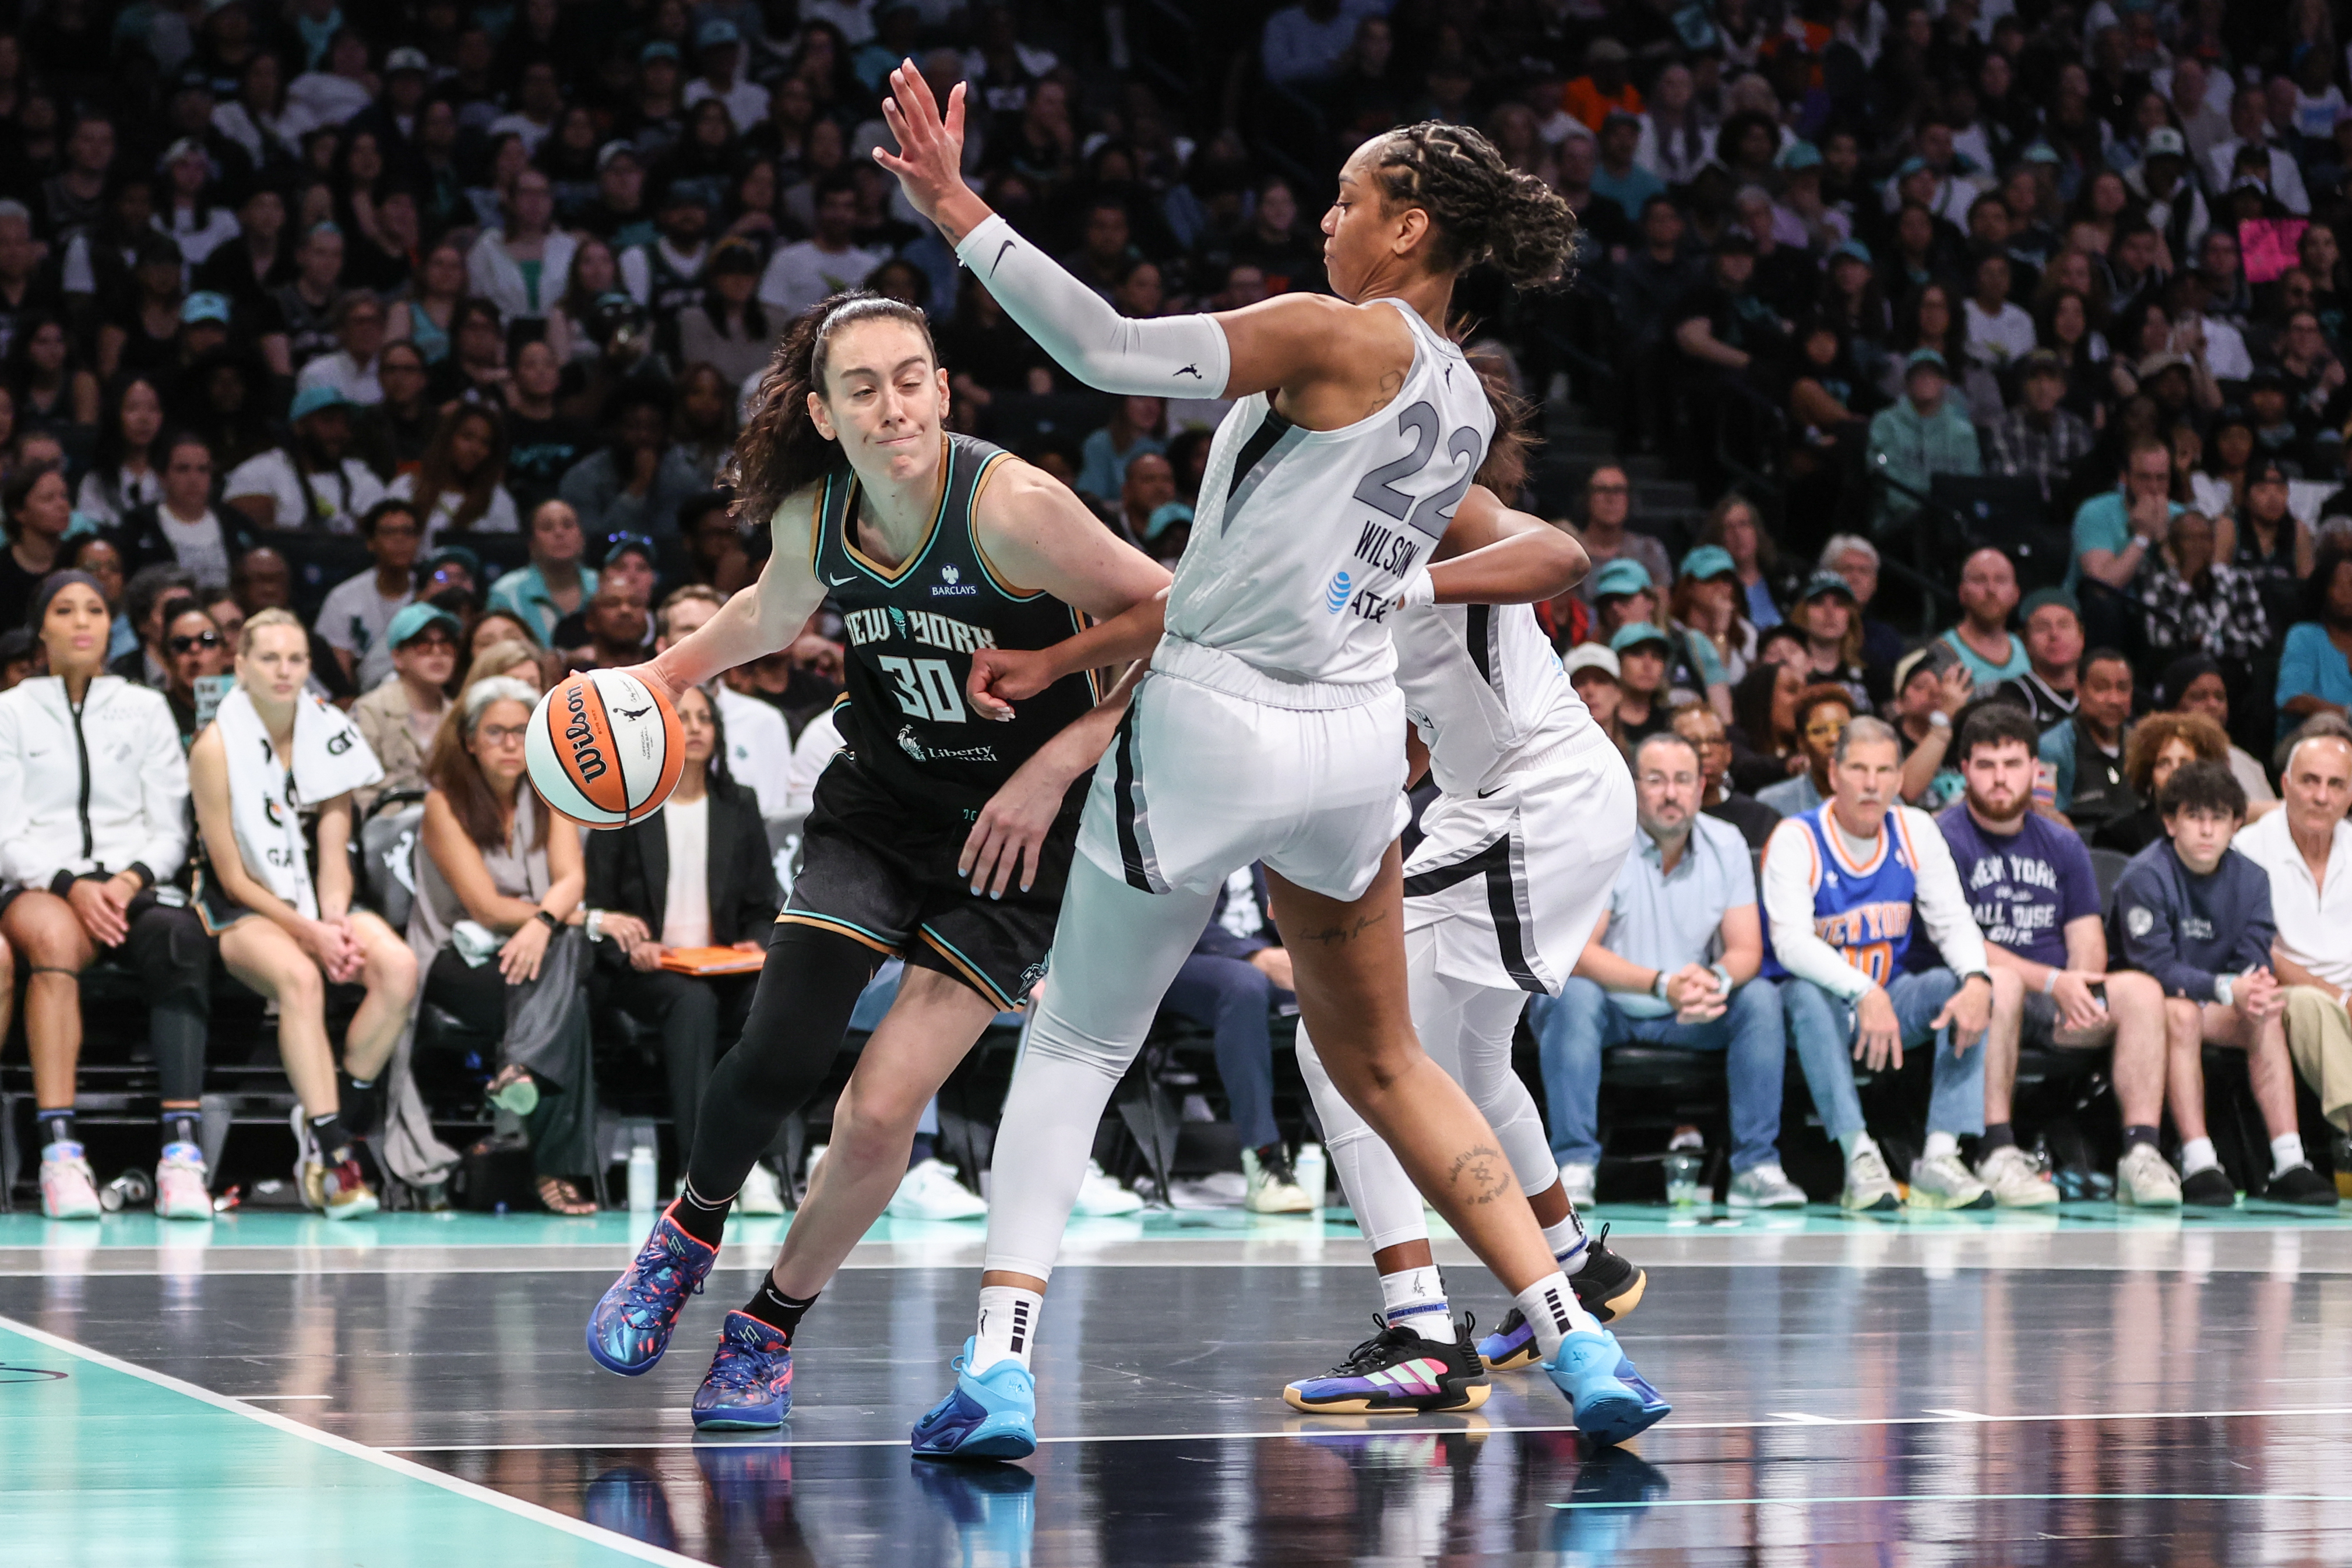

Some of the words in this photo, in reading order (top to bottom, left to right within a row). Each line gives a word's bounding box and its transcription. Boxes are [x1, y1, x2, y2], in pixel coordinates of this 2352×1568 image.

[1353, 401, 1482, 541] 22
[1354, 520, 1420, 580] WILSON
[932, 586, 977, 596] BARCLAYS
[1350, 589, 1396, 624] AT&
[844, 607, 892, 647] NEW
[906, 610, 998, 654] YORK
[877, 654, 967, 723] 30
[565, 683, 607, 784] Wilson
[927, 746, 991, 758] Liberty
